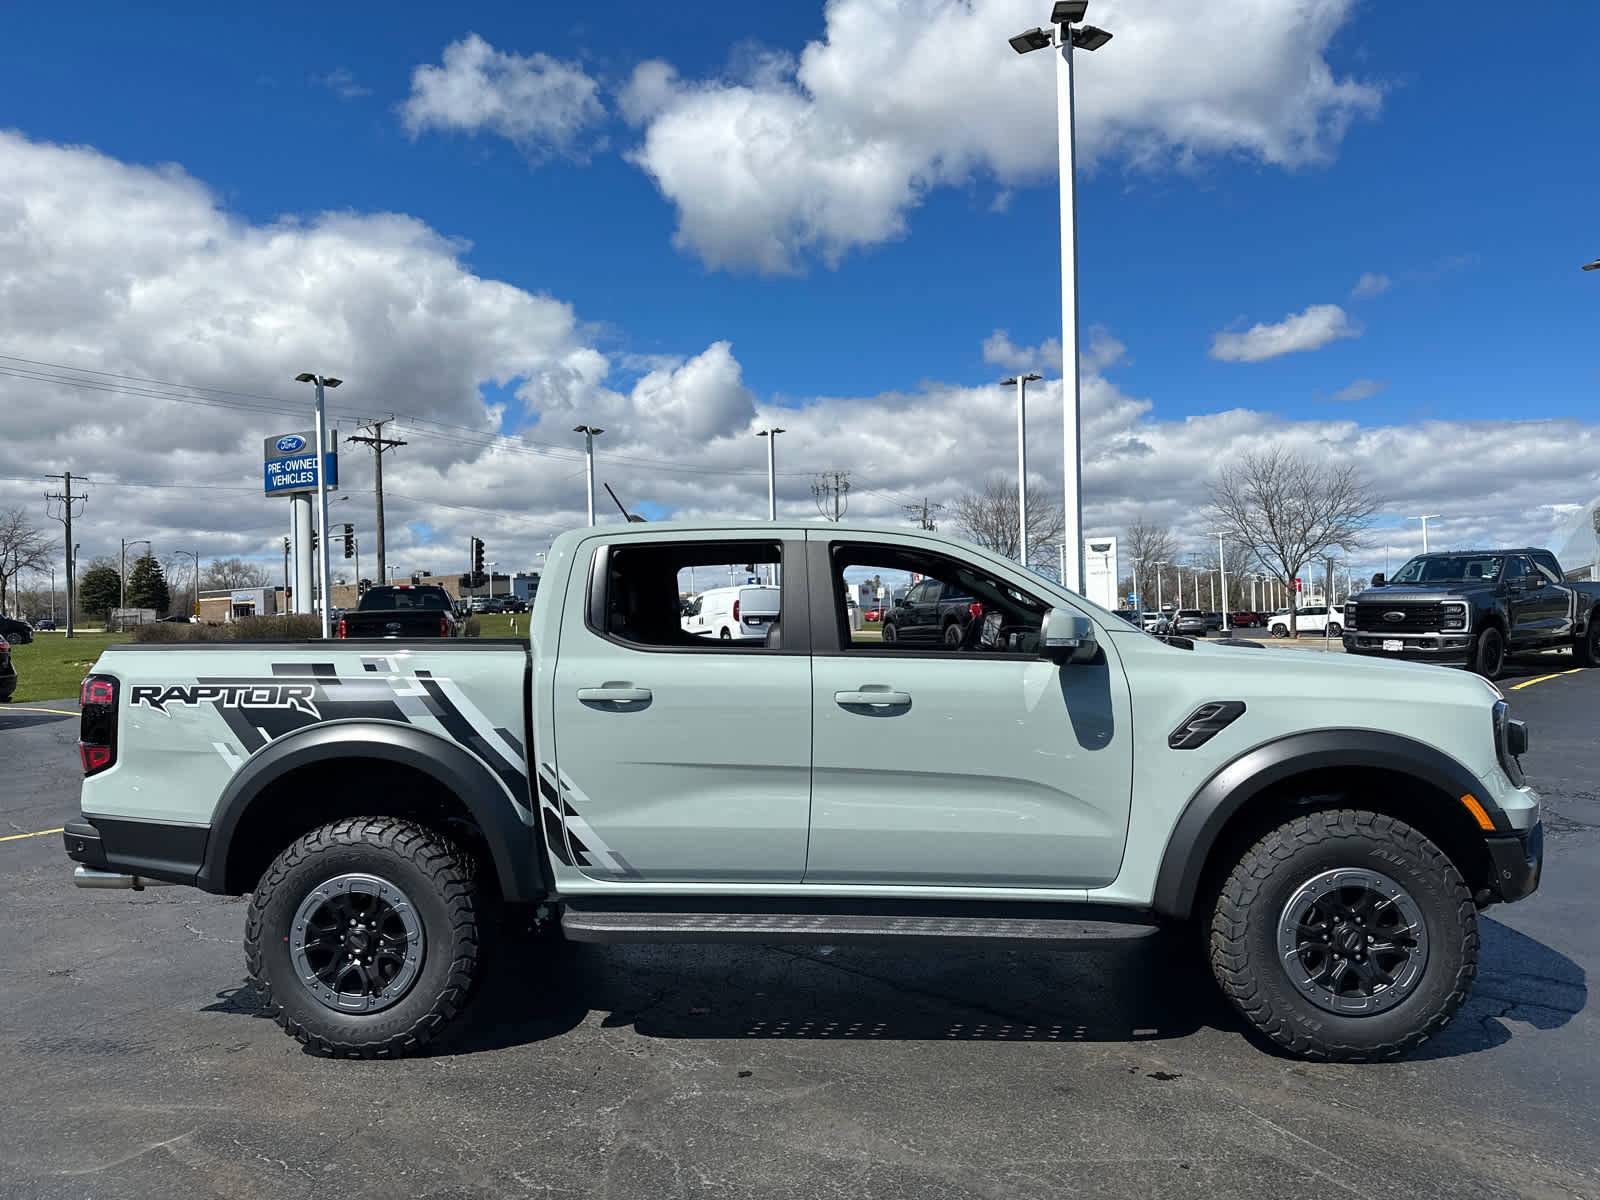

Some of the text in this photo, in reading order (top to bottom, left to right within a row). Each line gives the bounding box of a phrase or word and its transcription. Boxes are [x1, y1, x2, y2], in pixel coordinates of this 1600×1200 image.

[280, 438, 298, 450] Ford
[272, 472, 314, 487] VEHICLES
[129, 684, 322, 720] RAPTOR
